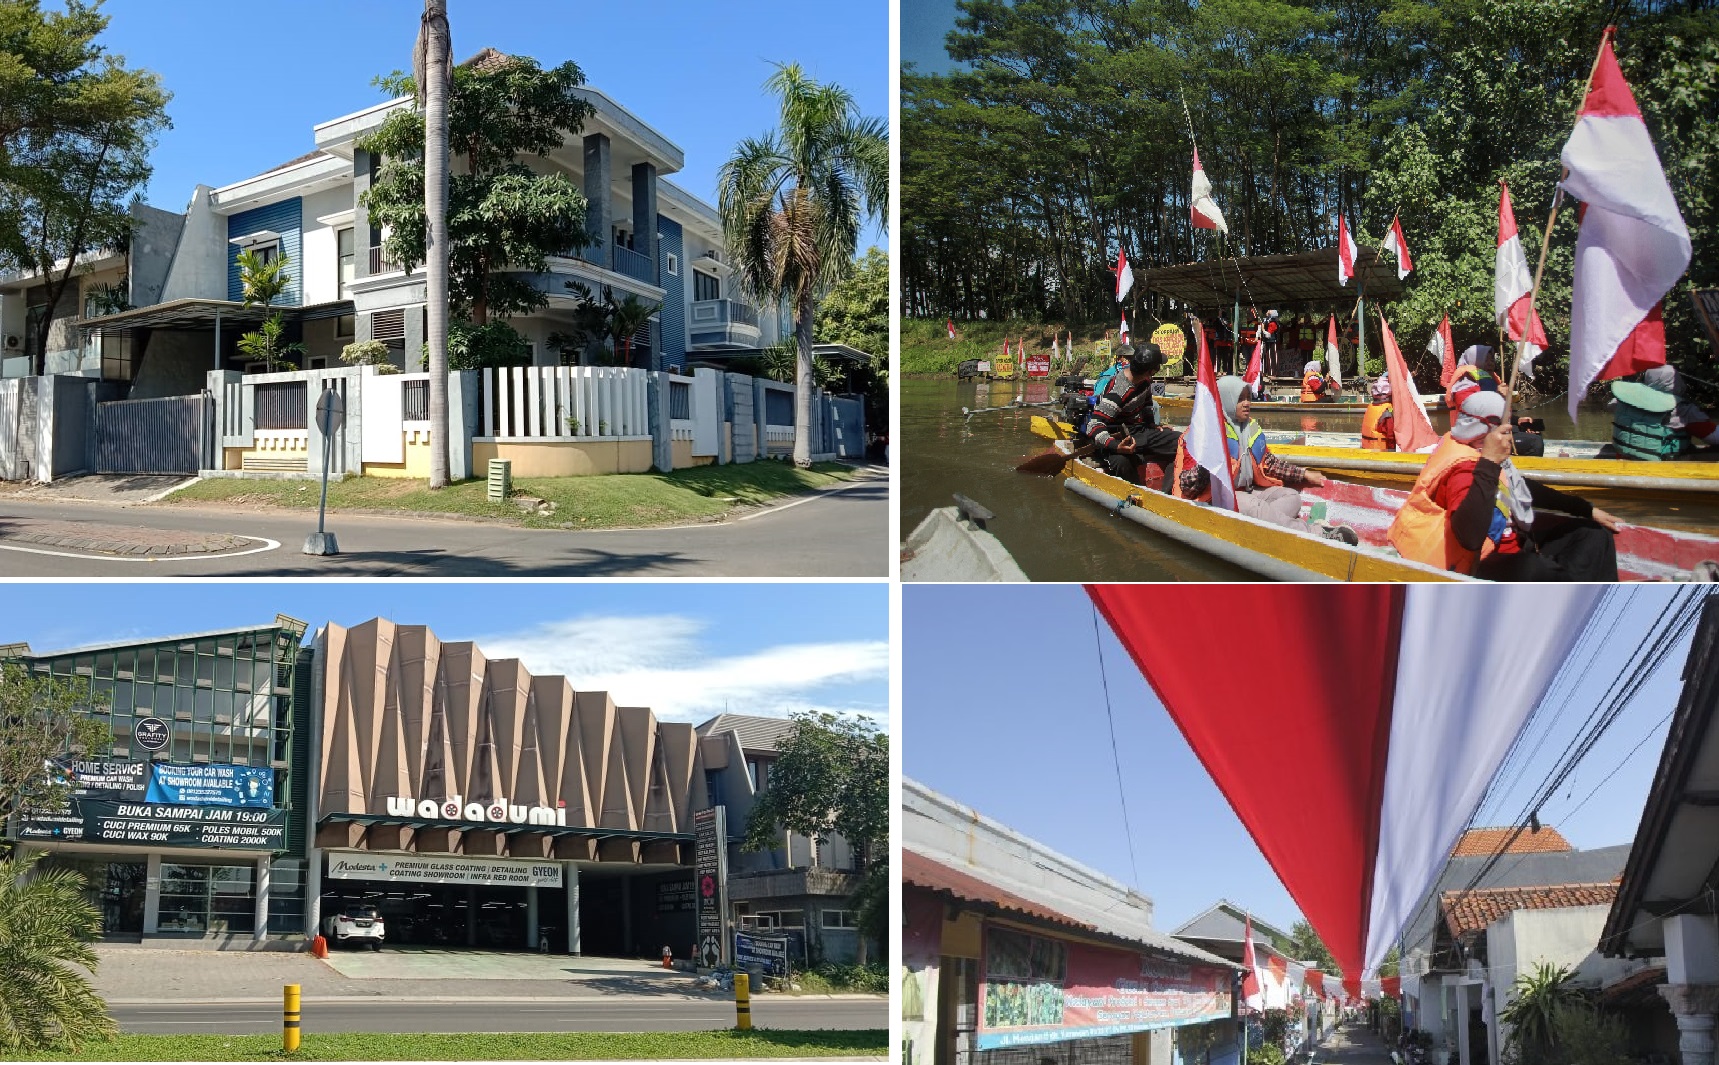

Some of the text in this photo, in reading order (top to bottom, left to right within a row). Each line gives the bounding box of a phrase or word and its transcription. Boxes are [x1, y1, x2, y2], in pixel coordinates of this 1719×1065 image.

[138, 731, 167, 739] GRAFITY
[72, 760, 143, 775] HOME SERVICE
[159, 765, 234, 778] BOOKING YOUR CAR WASH
[95, 782, 122, 790] DETAILING
[159, 776, 233, 788] AT SHOWROOM AVAILABLE
[118, 805, 267, 822] BUKA SAMPAI JAM 19:00
[386, 795, 567, 827] wadadumi
[63, 827, 84, 835] GYEON
[103, 821, 191, 832] CUCI PREMIUM 65K
[202, 825, 283, 836] POLES MOBIL 500K
[103, 830, 126, 838] CUCI
[127, 831, 149, 840] WAX
[201, 835, 267, 844] COATING 2000K
[389, 869, 421, 877] COATING
[423, 871, 465, 879] SHOWROOM
[455, 864, 487, 872] COATING
[491, 866, 528, 874] DETAILING
[532, 866, 559, 877] GYEON
